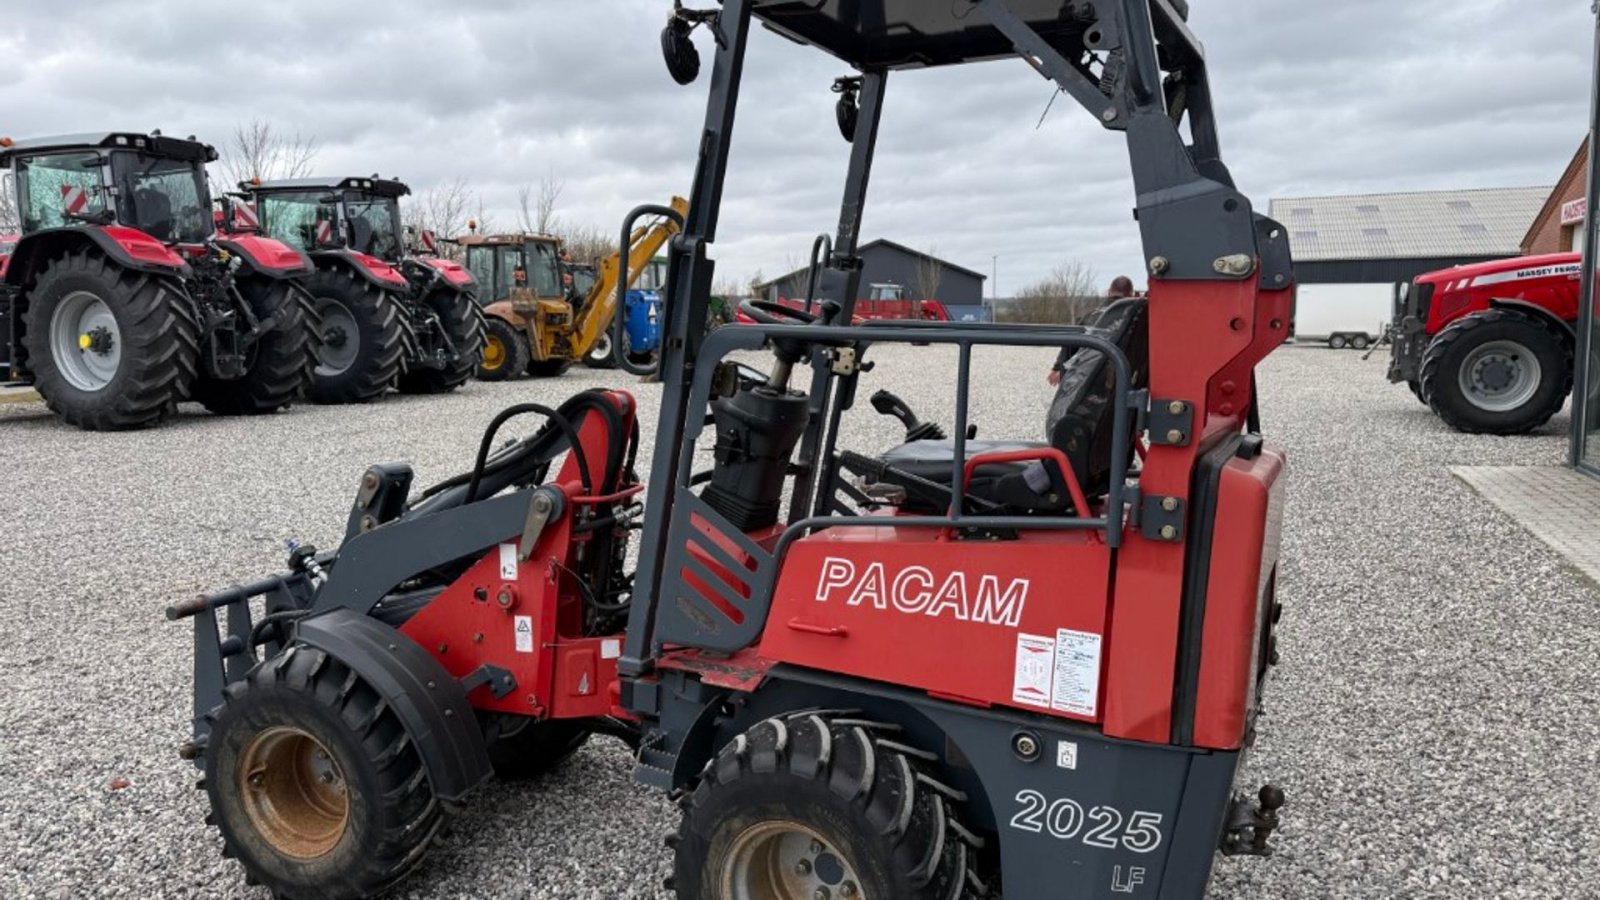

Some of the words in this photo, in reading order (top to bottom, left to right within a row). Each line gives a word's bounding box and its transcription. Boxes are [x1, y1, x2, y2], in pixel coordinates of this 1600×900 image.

[1517, 268, 1552, 278] MASSEY
[815, 556, 1030, 627] PACAM
[1010, 789, 1162, 853] 2025
[1111, 865, 1145, 893] LF
